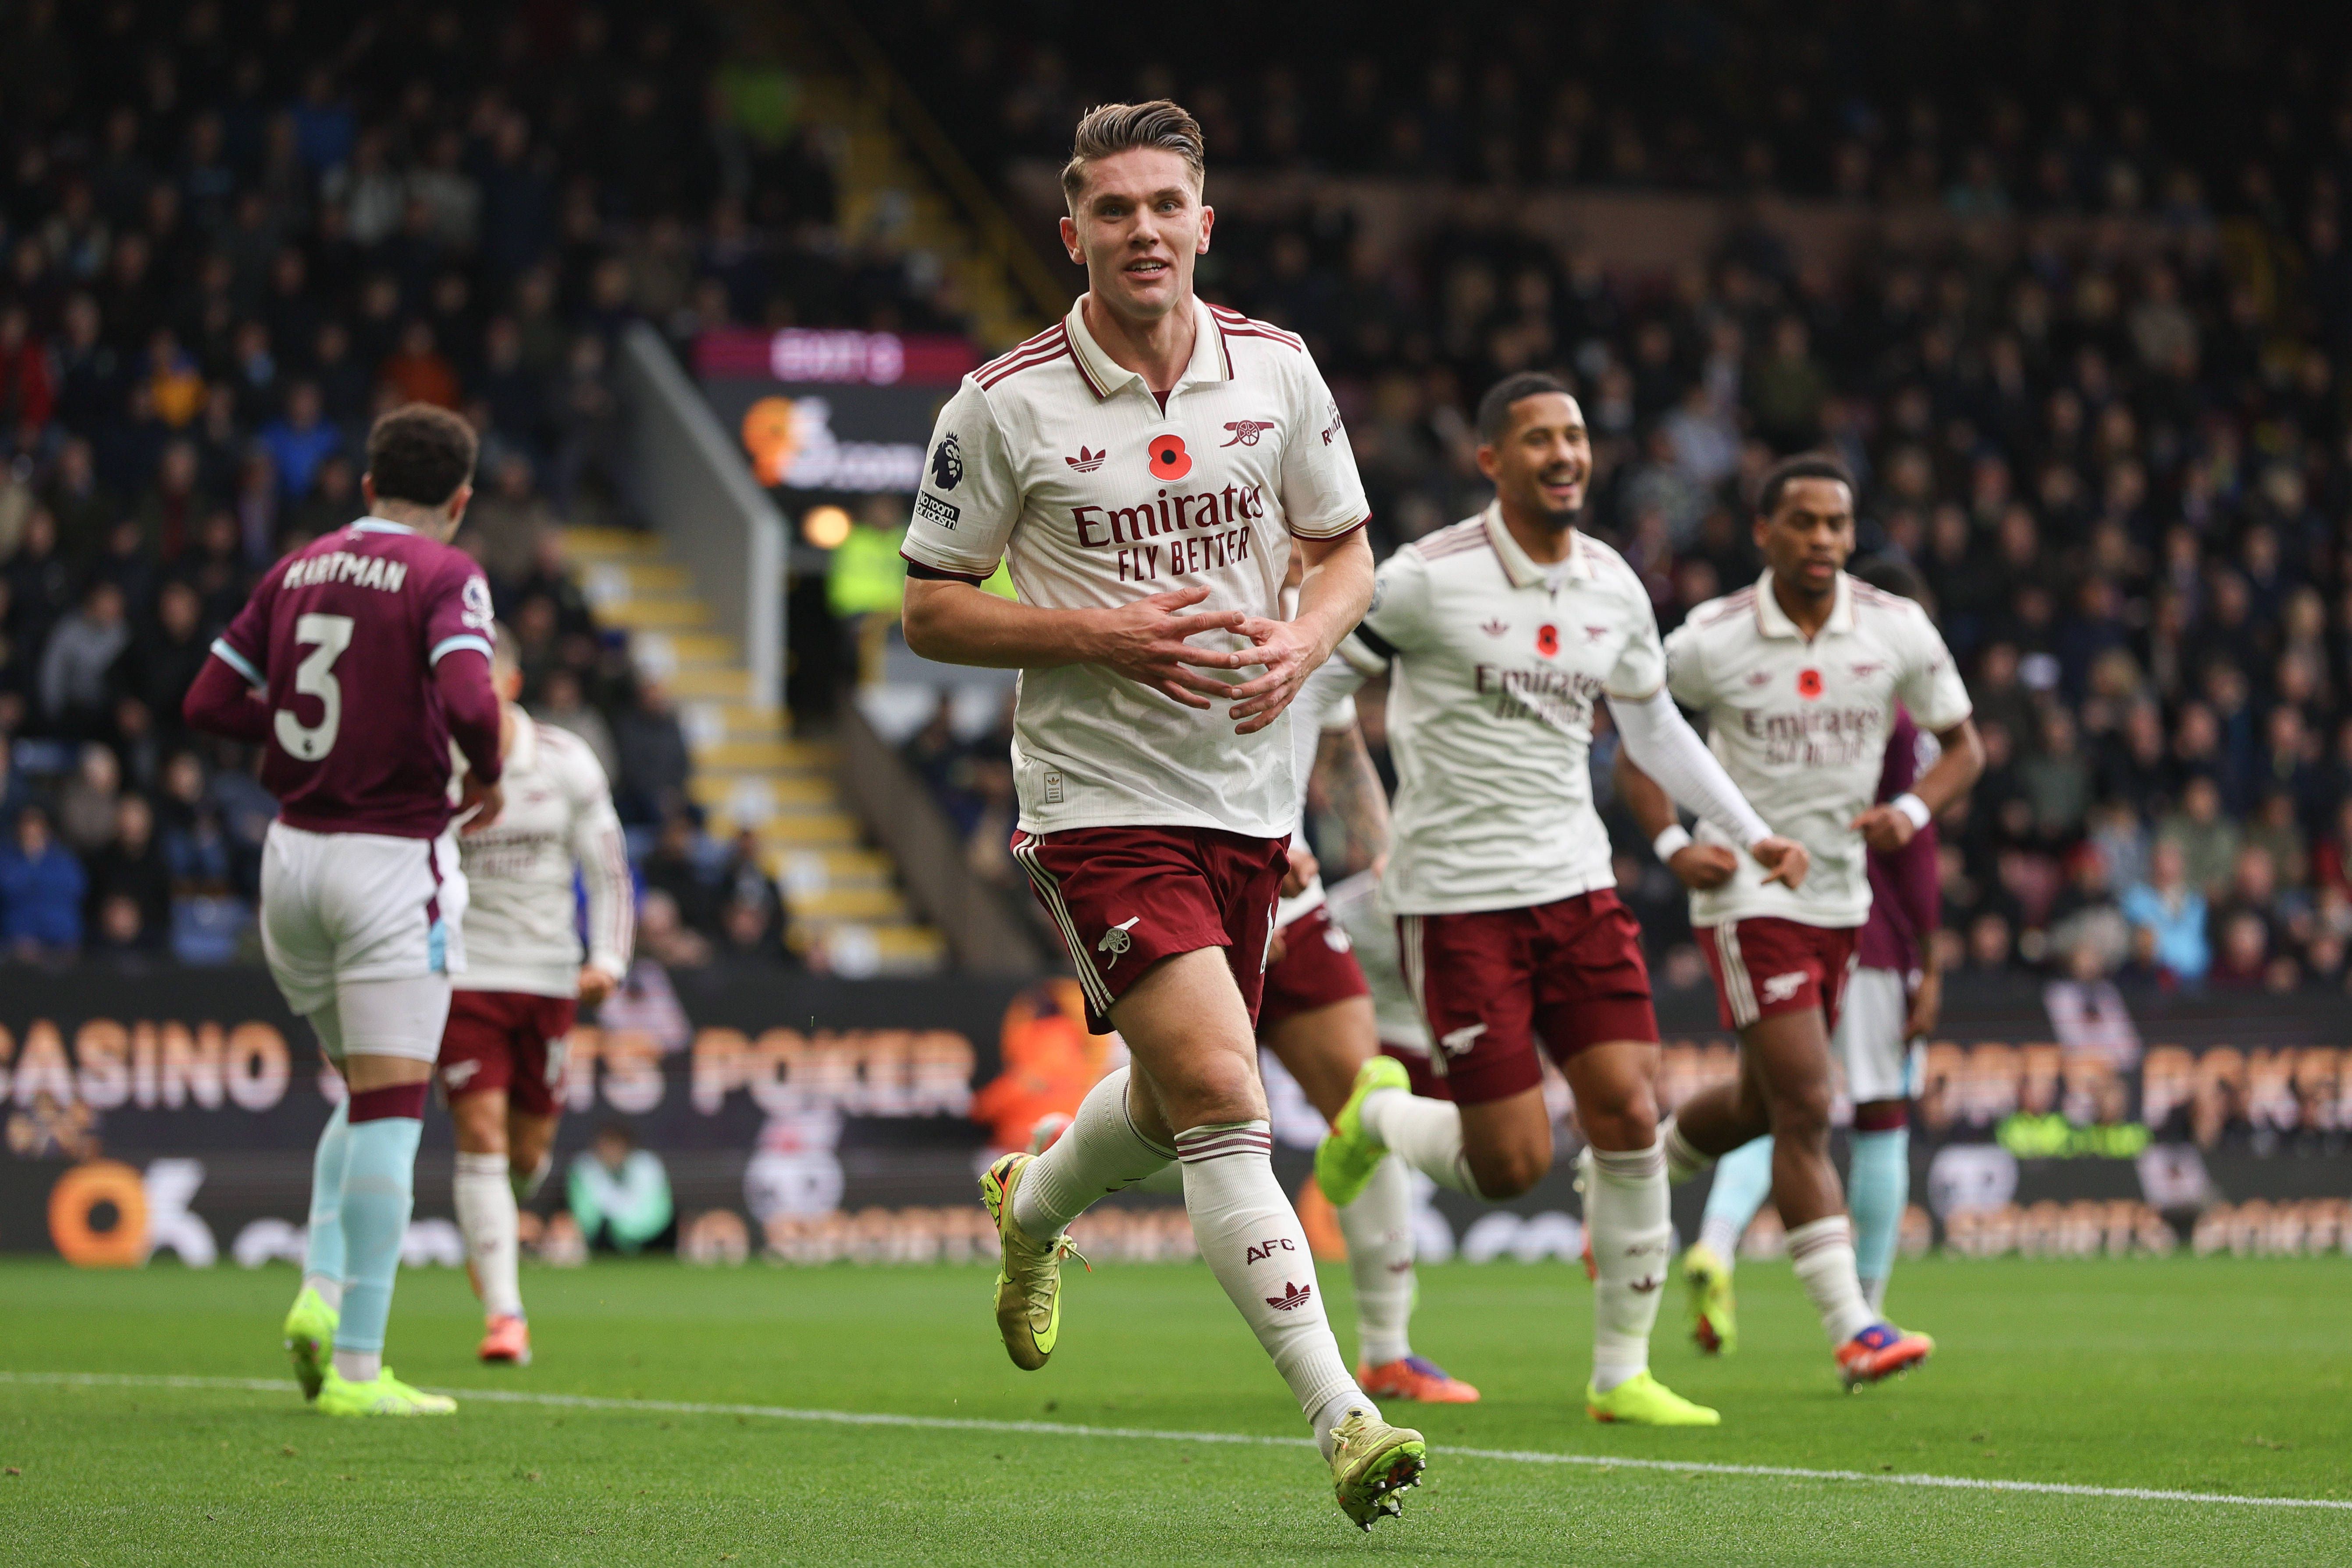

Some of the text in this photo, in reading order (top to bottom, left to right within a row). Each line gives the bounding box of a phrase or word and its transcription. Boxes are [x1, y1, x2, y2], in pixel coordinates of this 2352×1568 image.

[918, 491, 954, 518] No room
[924, 508, 956, 530] racism
[1070, 482, 1263, 548] Emirates
[1117, 526, 1250, 581] FLY BETTER
[274, 612, 355, 762] 3
[1247, 1238, 1295, 1266] AFC
